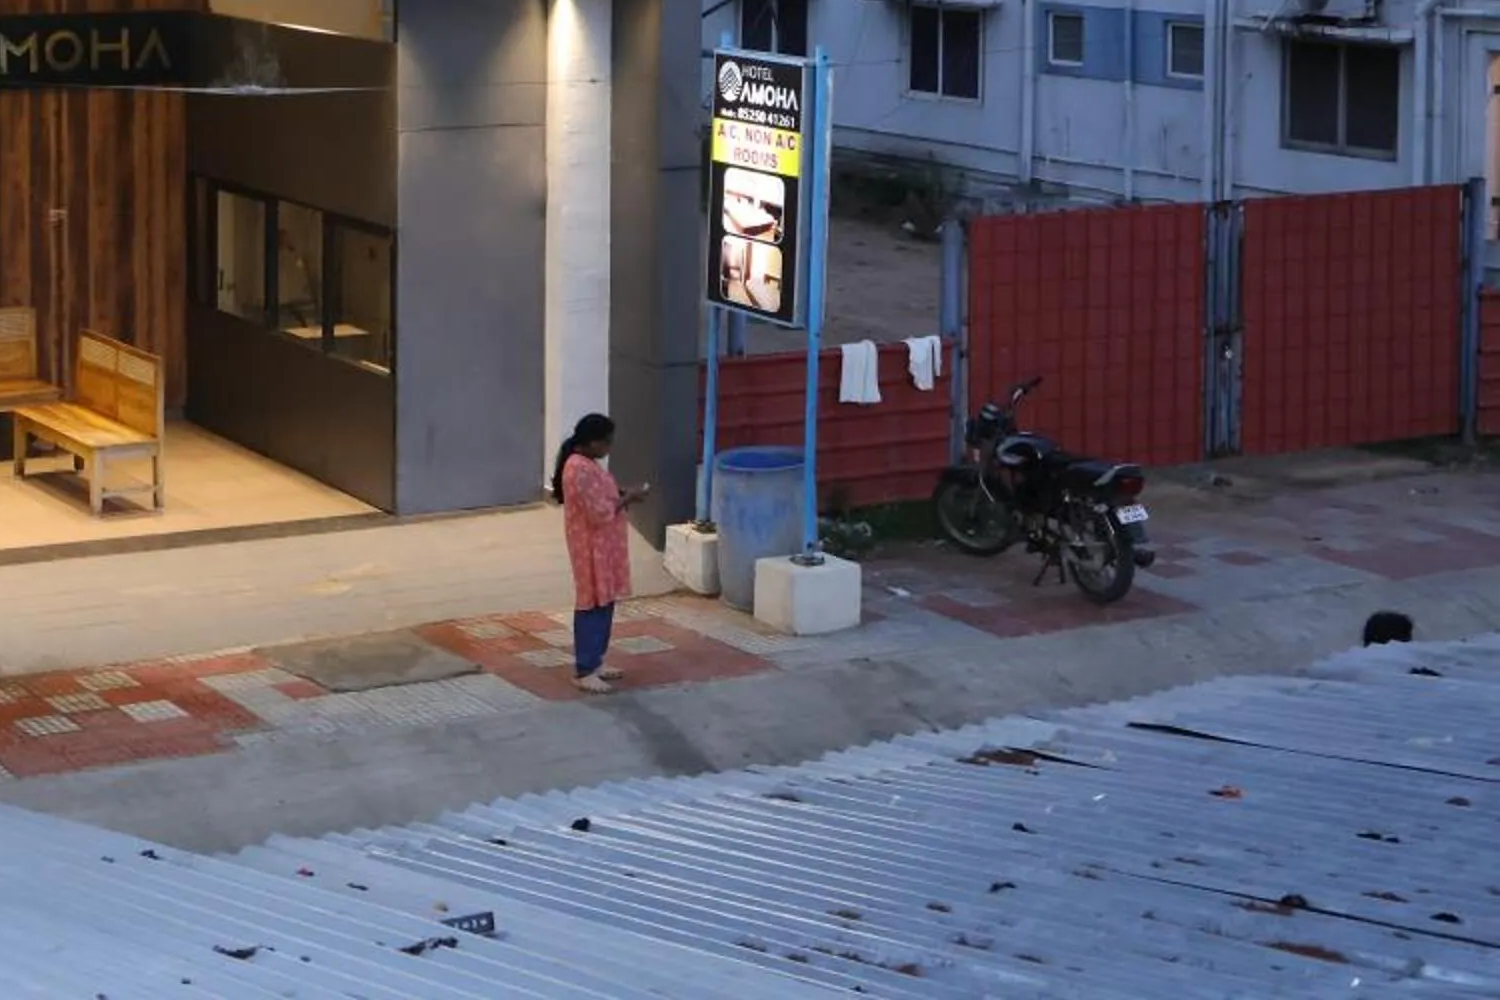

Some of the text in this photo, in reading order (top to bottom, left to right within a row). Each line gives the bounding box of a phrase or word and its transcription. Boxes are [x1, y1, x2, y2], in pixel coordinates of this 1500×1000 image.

[741, 65, 774, 82] HOTEL
[739, 81, 799, 111] AMOHA
[746, 127, 772, 145] NON
[733, 146, 778, 169] ROOMS
